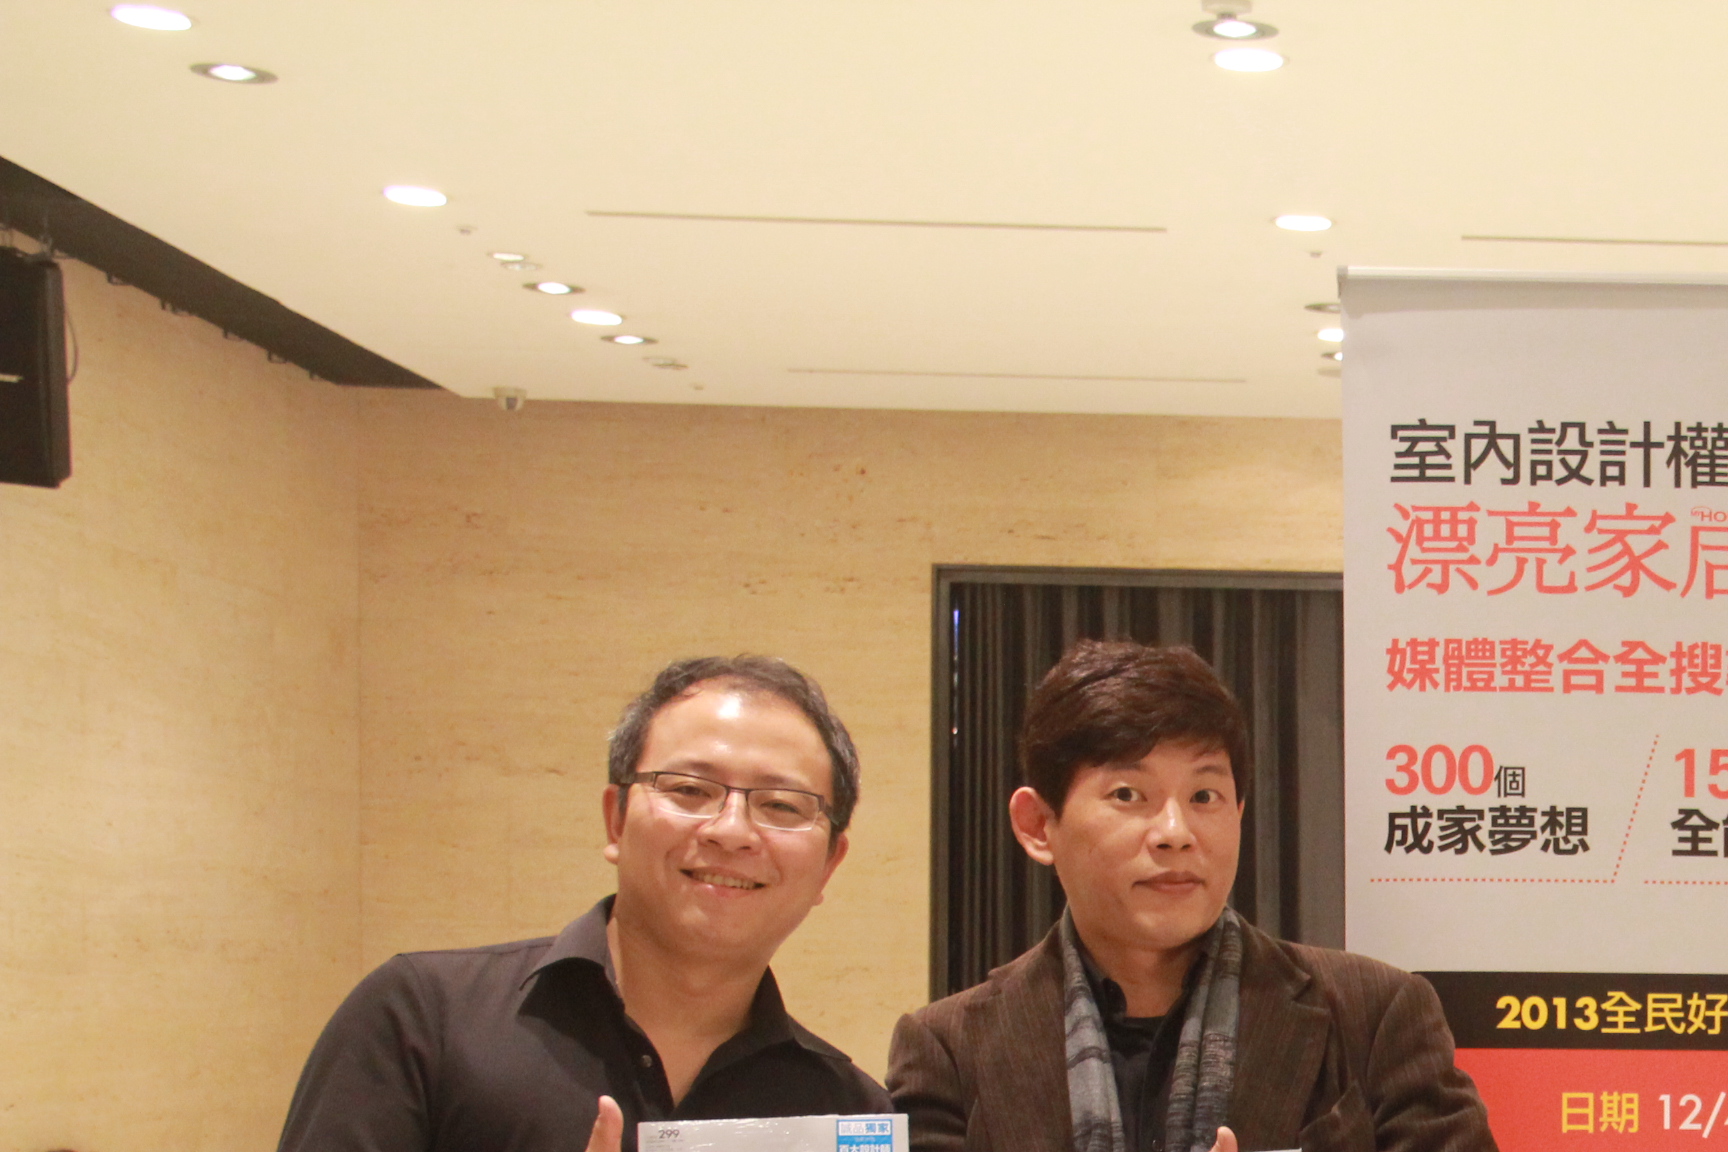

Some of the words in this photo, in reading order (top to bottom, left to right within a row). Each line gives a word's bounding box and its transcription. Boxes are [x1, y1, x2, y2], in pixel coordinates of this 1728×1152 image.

[1385, 743, 1526, 798] 300個
[1383, 805, 1590, 856] 成家夢想
[659, 1129, 679, 1139] 299
[1560, 1092, 1639, 1135] 日期
